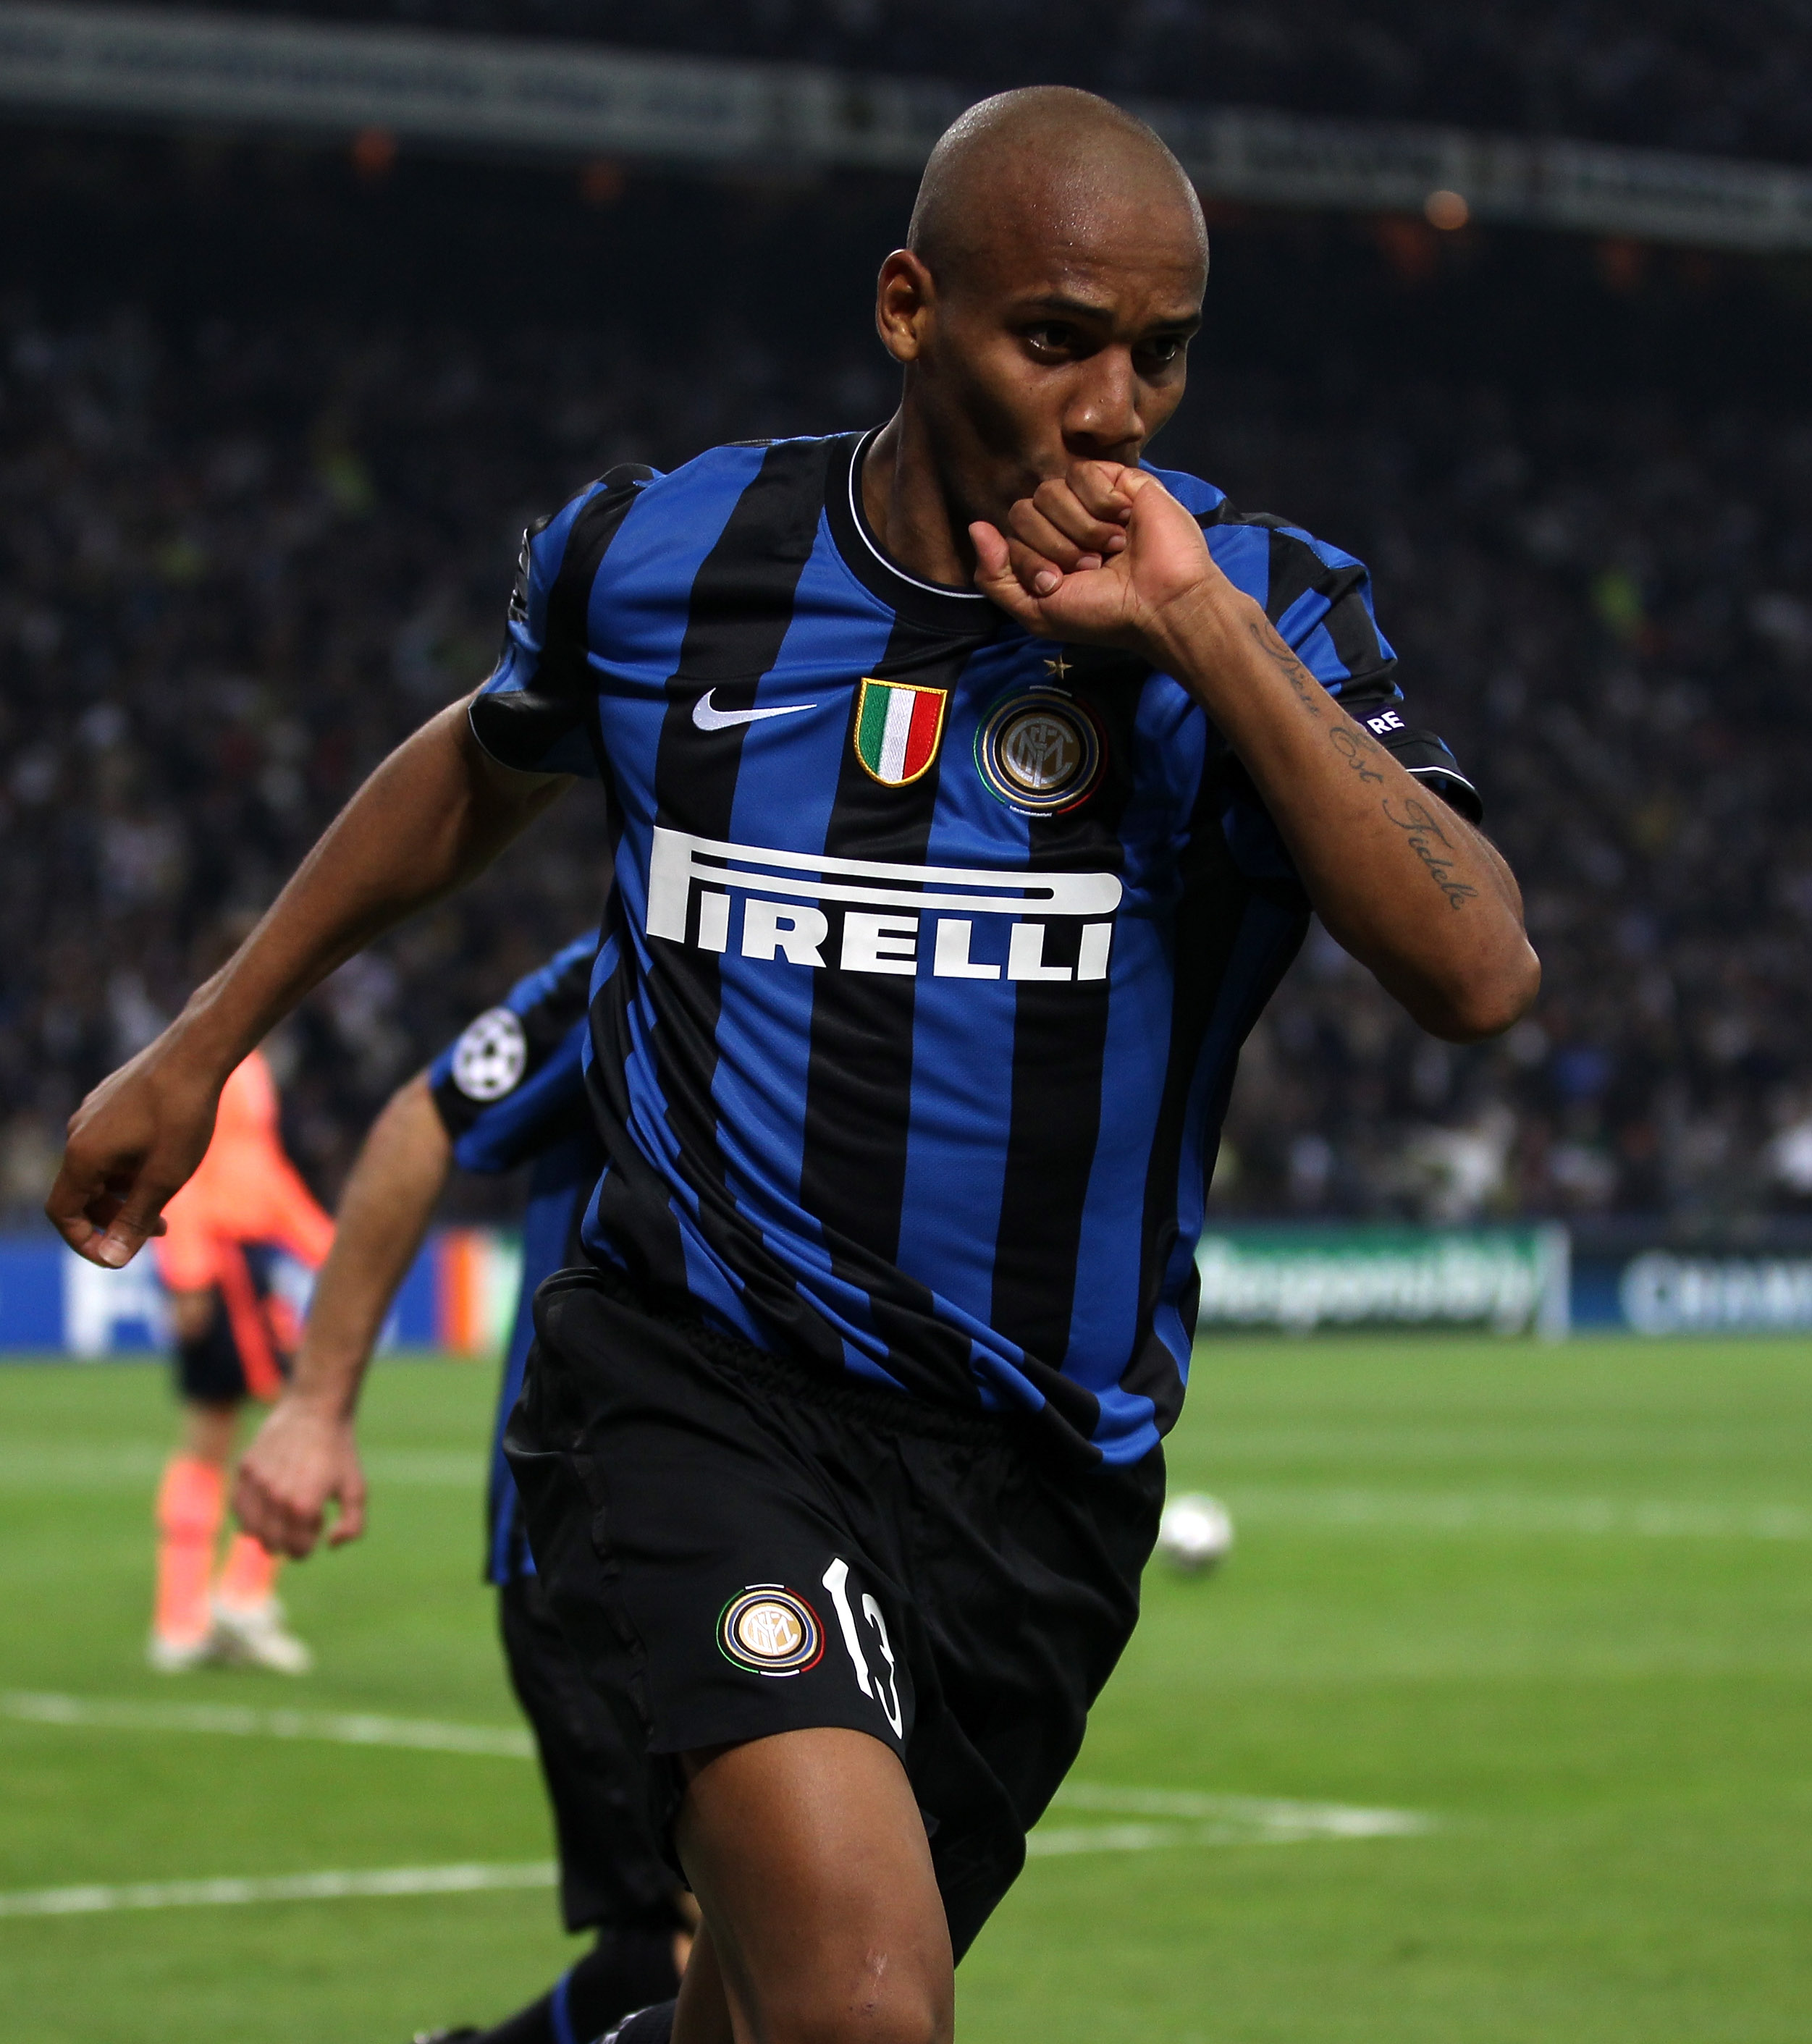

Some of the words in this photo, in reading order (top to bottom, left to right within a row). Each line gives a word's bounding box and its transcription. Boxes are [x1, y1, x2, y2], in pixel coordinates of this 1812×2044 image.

[1329, 726, 1384, 784] Est
[1367, 711, 1405, 734] RE
[646, 826, 1123, 981] PIRELLI
[822, 1557, 903, 1739] 13
